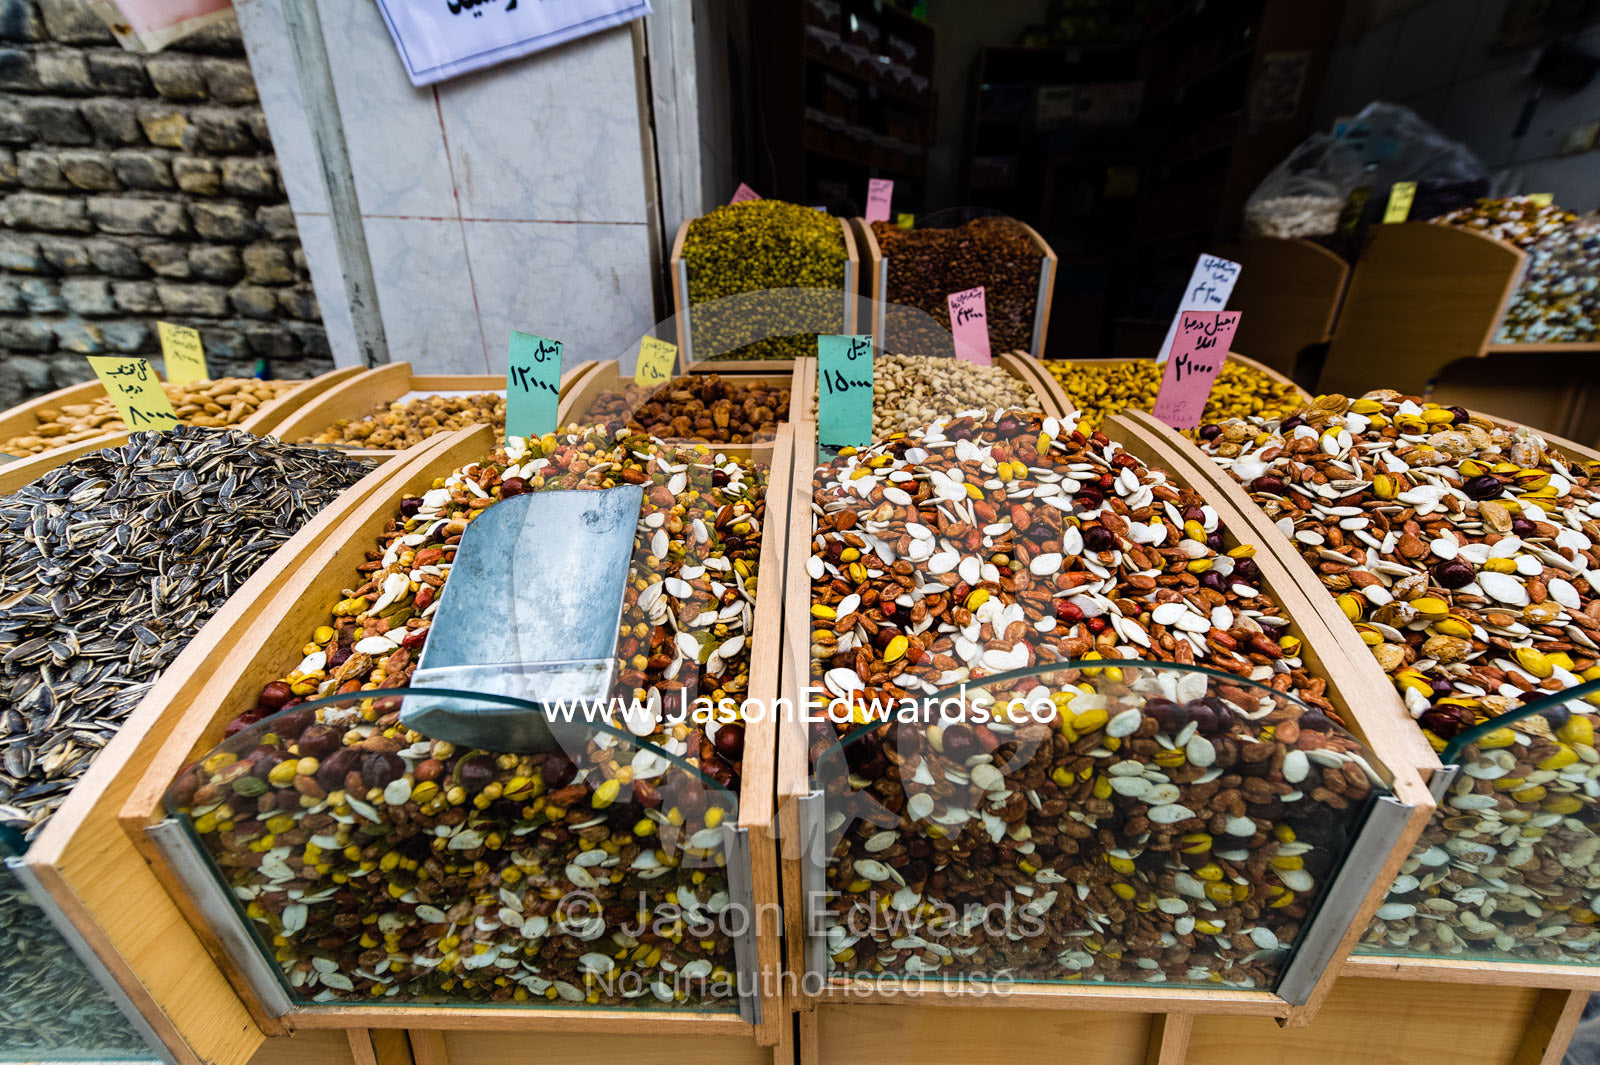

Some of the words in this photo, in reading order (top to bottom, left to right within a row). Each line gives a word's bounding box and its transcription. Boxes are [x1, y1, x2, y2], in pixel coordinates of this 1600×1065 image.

[847, 335, 872, 361] آجیل
[1176, 353, 1213, 382] ۲۱۰۰۰
[824, 369, 872, 395] ۱۵۰۰۰
